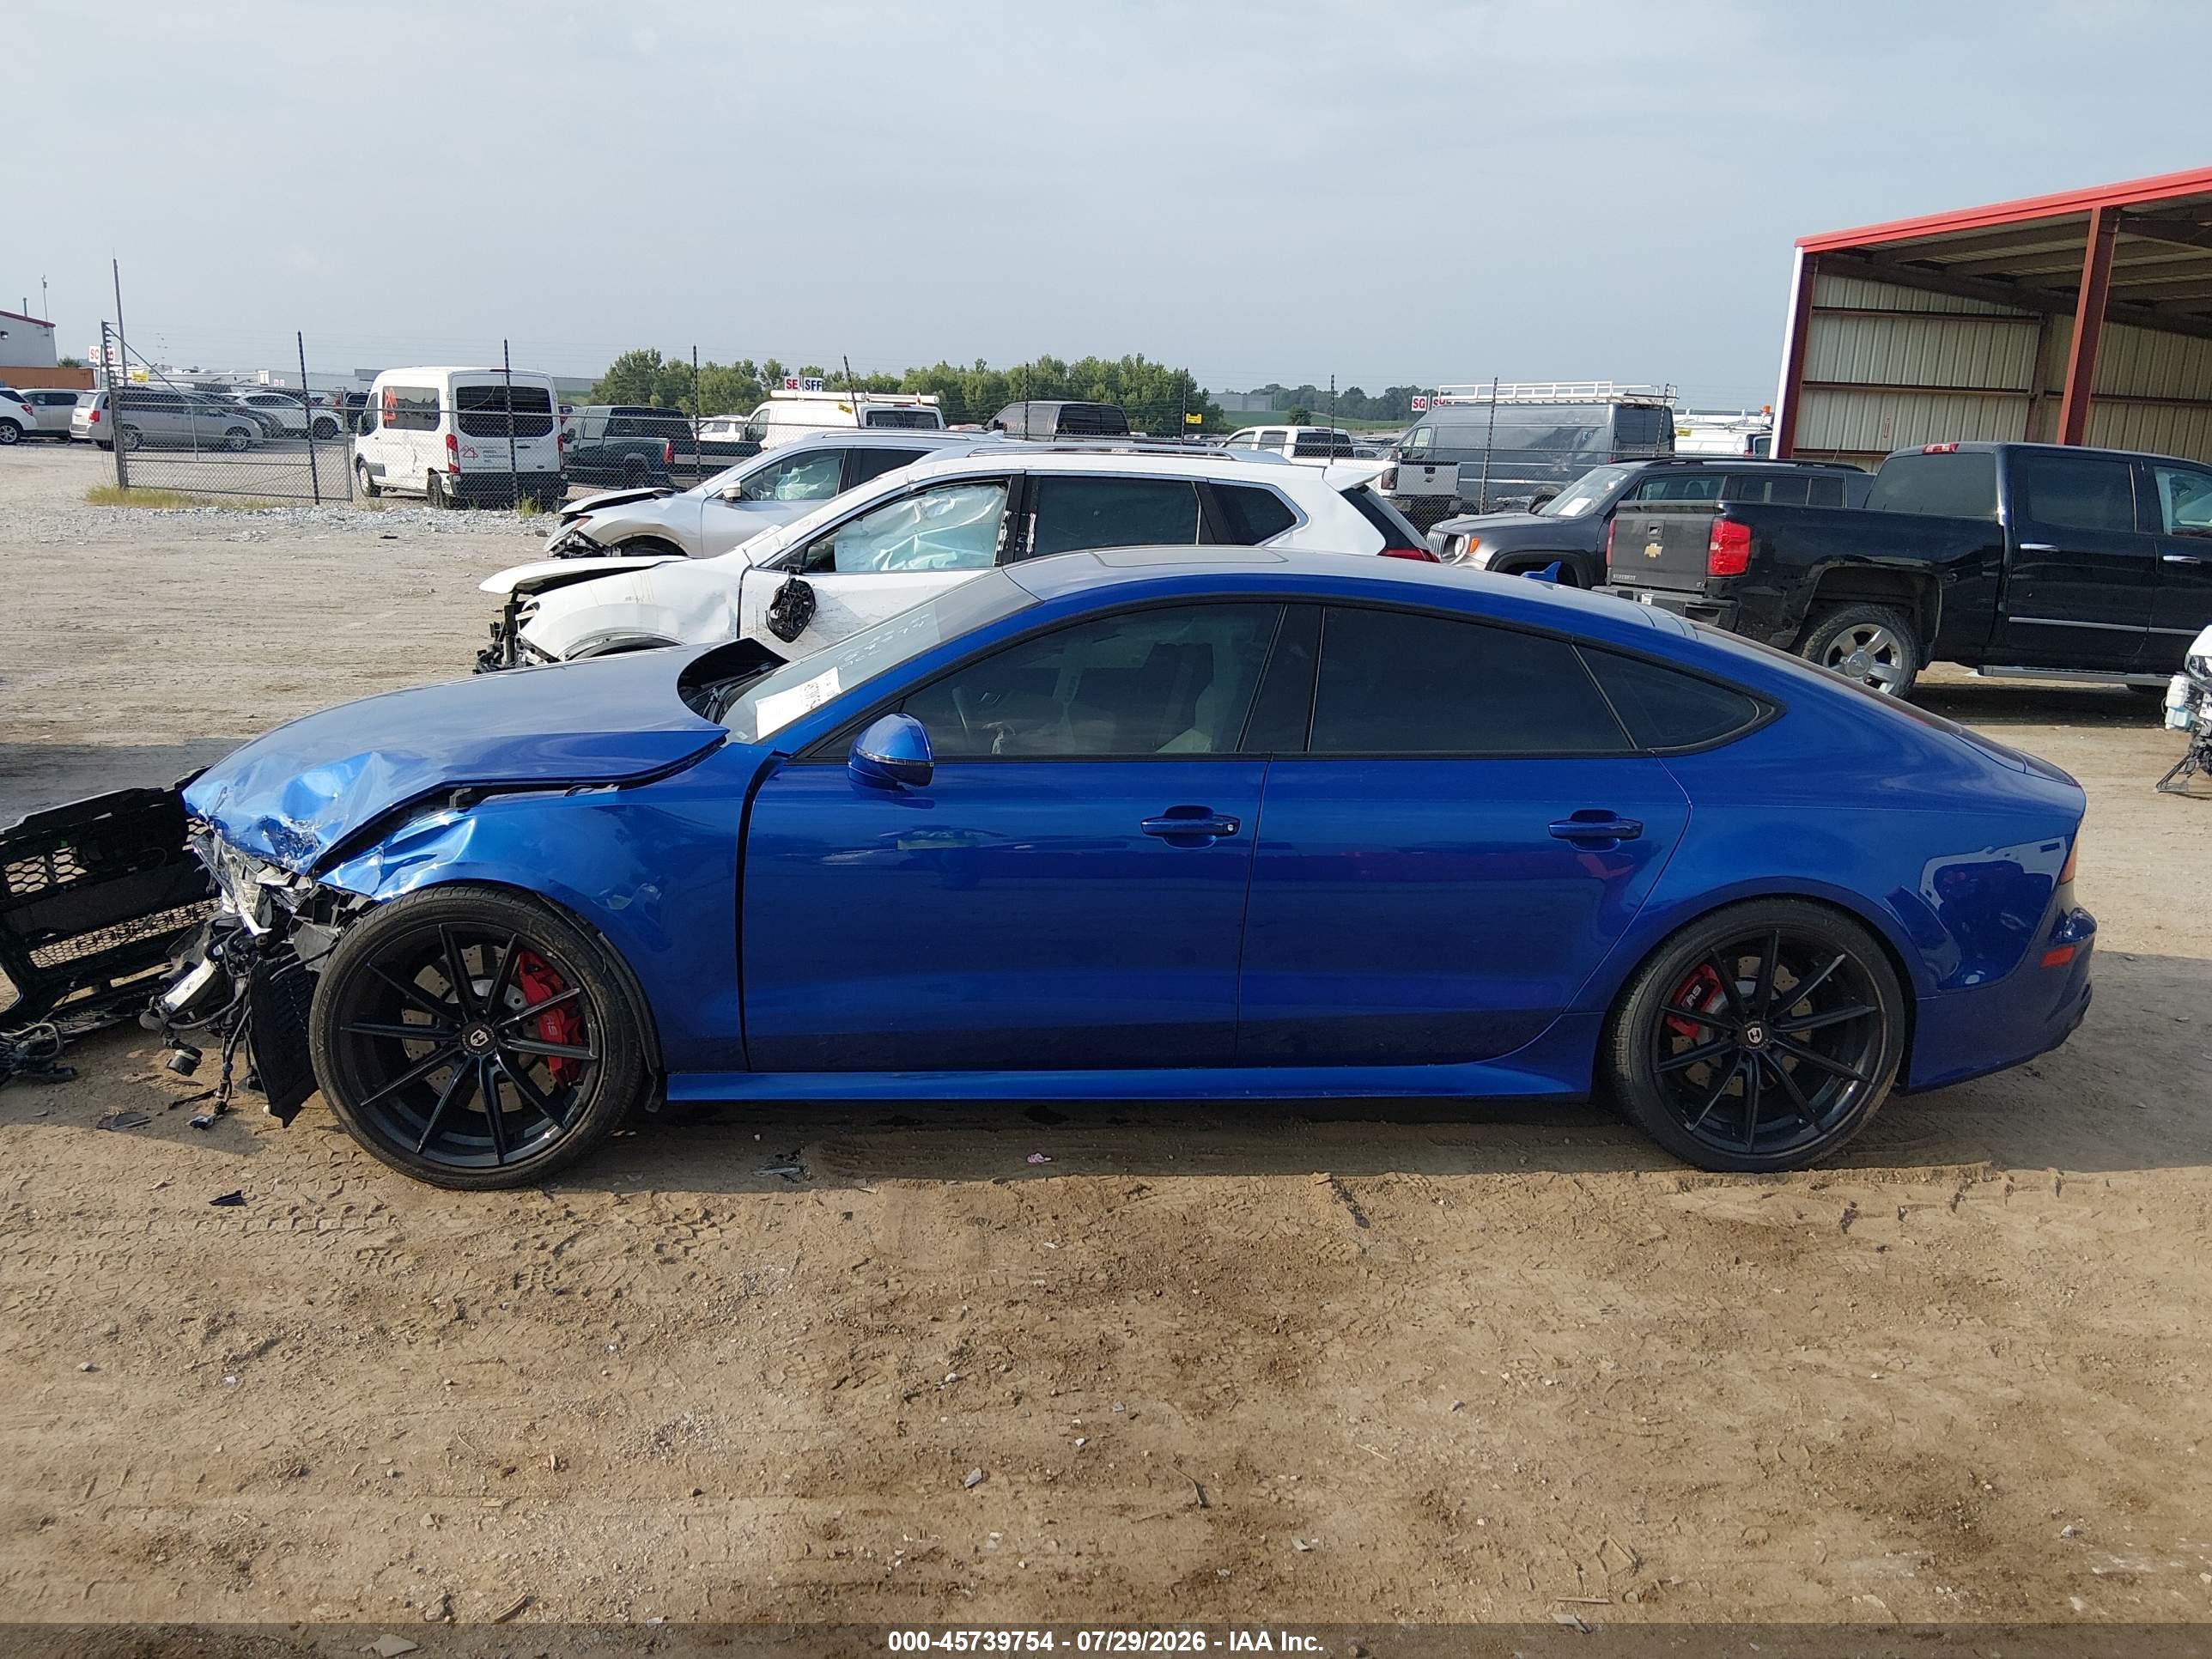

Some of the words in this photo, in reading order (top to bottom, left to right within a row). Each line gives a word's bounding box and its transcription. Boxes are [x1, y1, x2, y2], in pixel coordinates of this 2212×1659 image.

[786, 379, 799, 390] SE
[805, 379, 822, 391] SFF
[1413, 398, 1425, 409] SG
